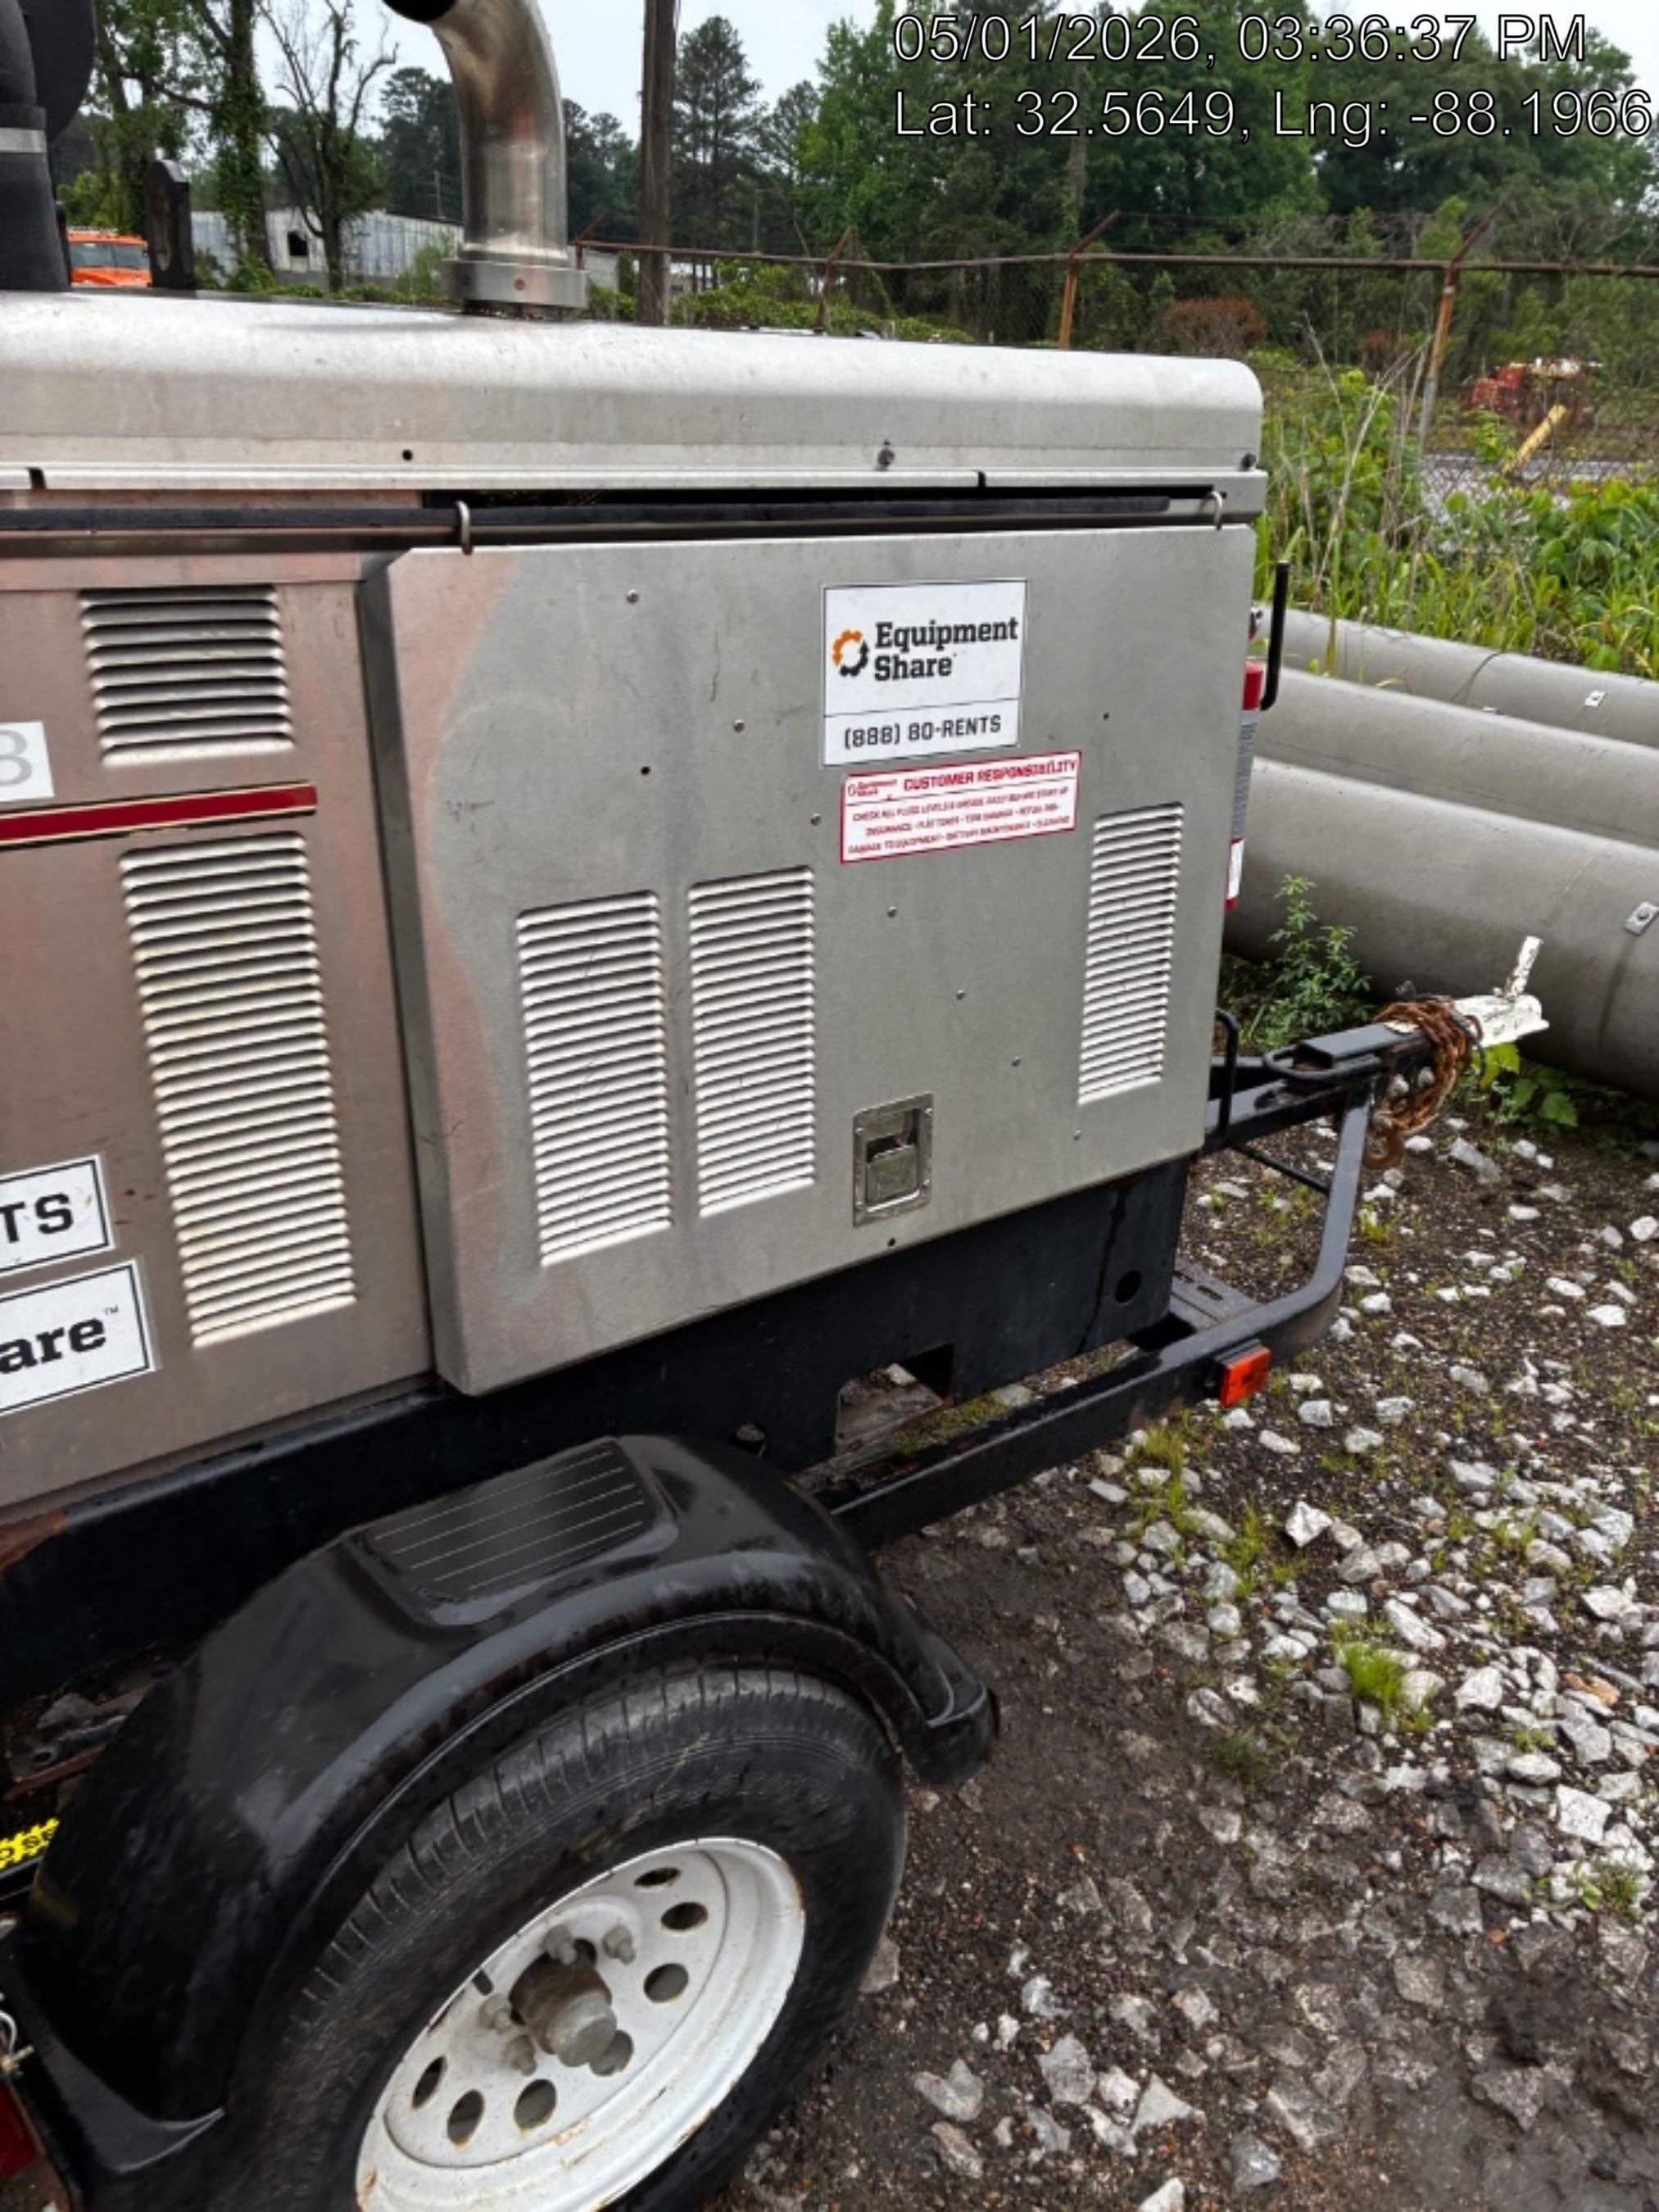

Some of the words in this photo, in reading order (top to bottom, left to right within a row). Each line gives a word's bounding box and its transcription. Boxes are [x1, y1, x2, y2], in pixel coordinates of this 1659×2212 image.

[875, 618, 1018, 652] Equipment
[873, 654, 953, 682] Share
[844, 723, 900, 750] (888)
[909, 714, 1002, 741] 80-RENTS
[904, 771, 975, 792] CUSTOMER
[977, 758, 1077, 783] RESPONSIBILITY
[0, 1193, 74, 1244] TS
[0, 1317, 107, 1375] are
